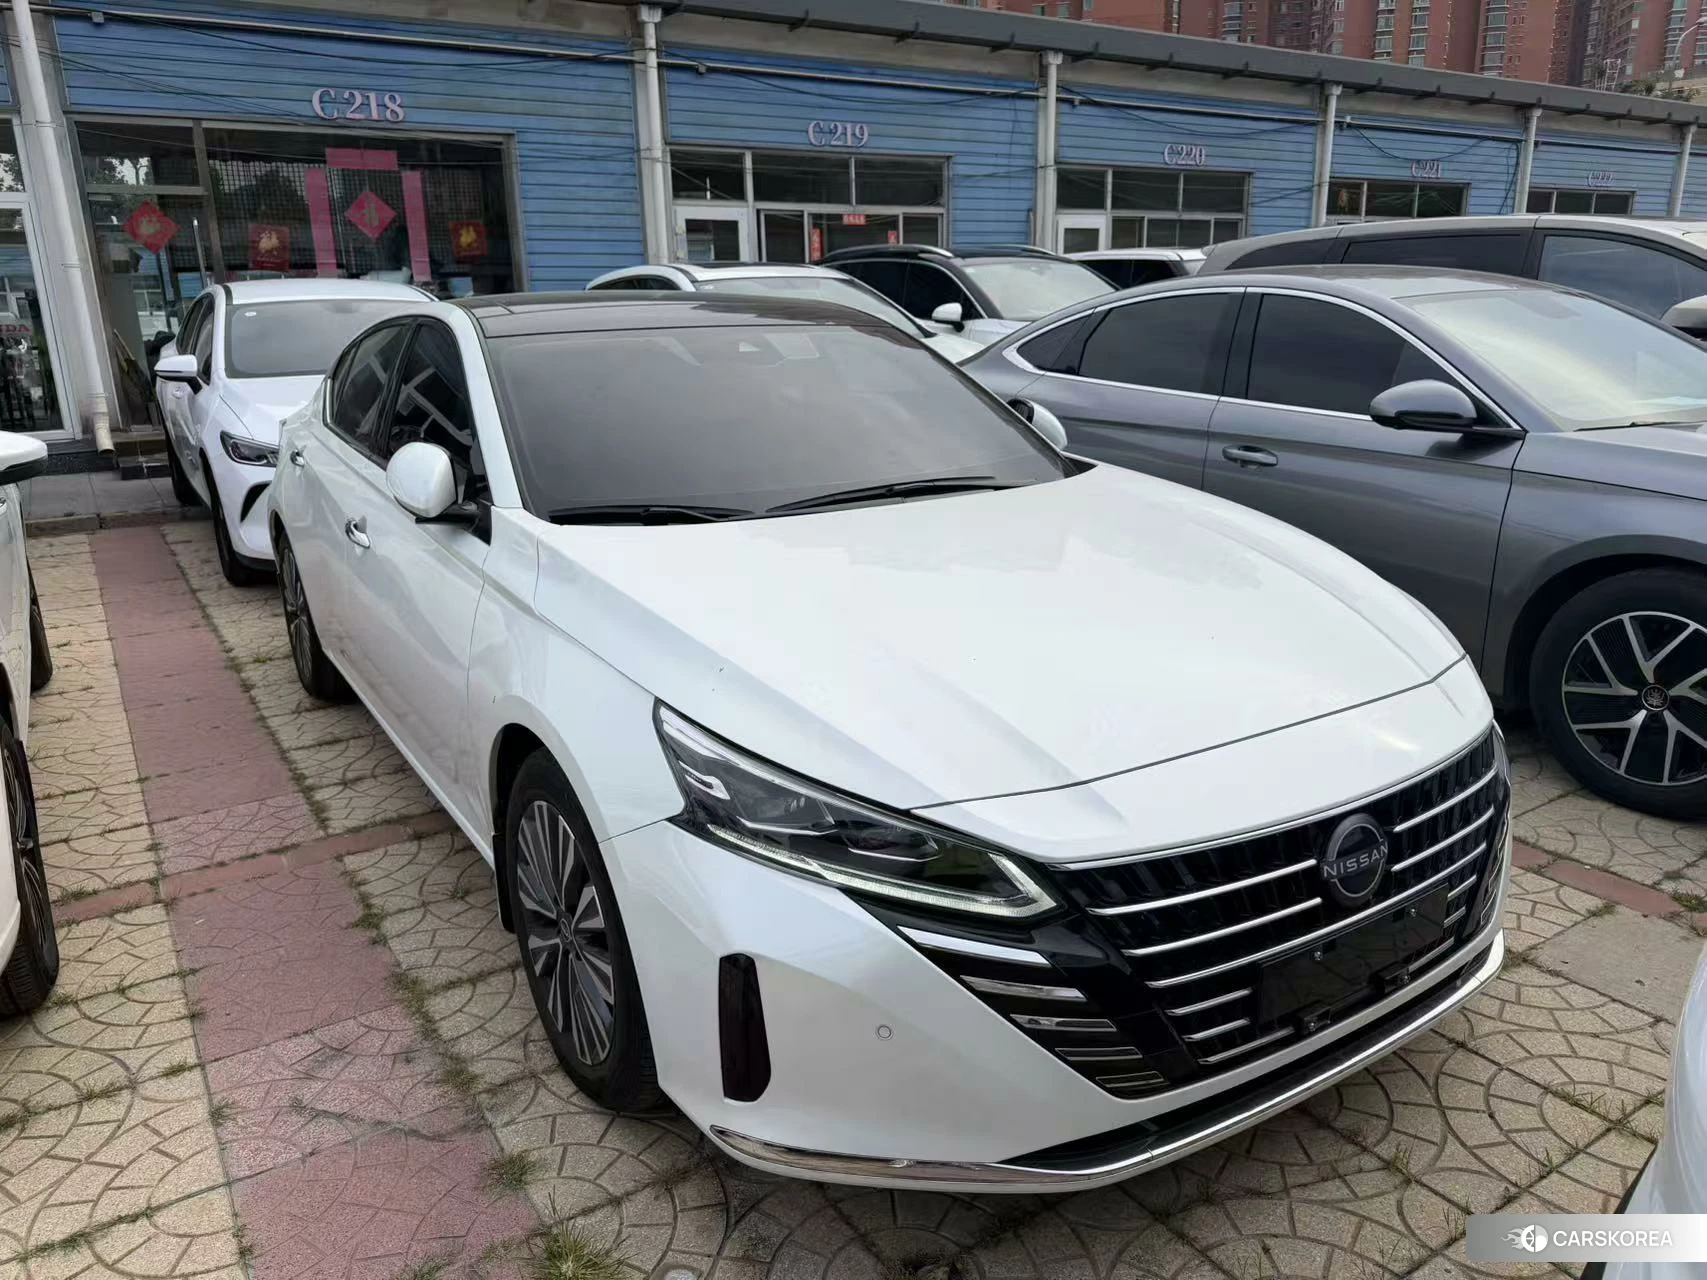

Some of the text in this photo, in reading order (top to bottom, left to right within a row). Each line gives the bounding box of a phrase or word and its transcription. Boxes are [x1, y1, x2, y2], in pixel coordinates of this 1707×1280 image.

[312, 88, 404, 121] C218
[807, 121, 869, 147] C219
[1164, 143, 1205, 166] C220
[1323, 845, 1388, 877] NISSAN
